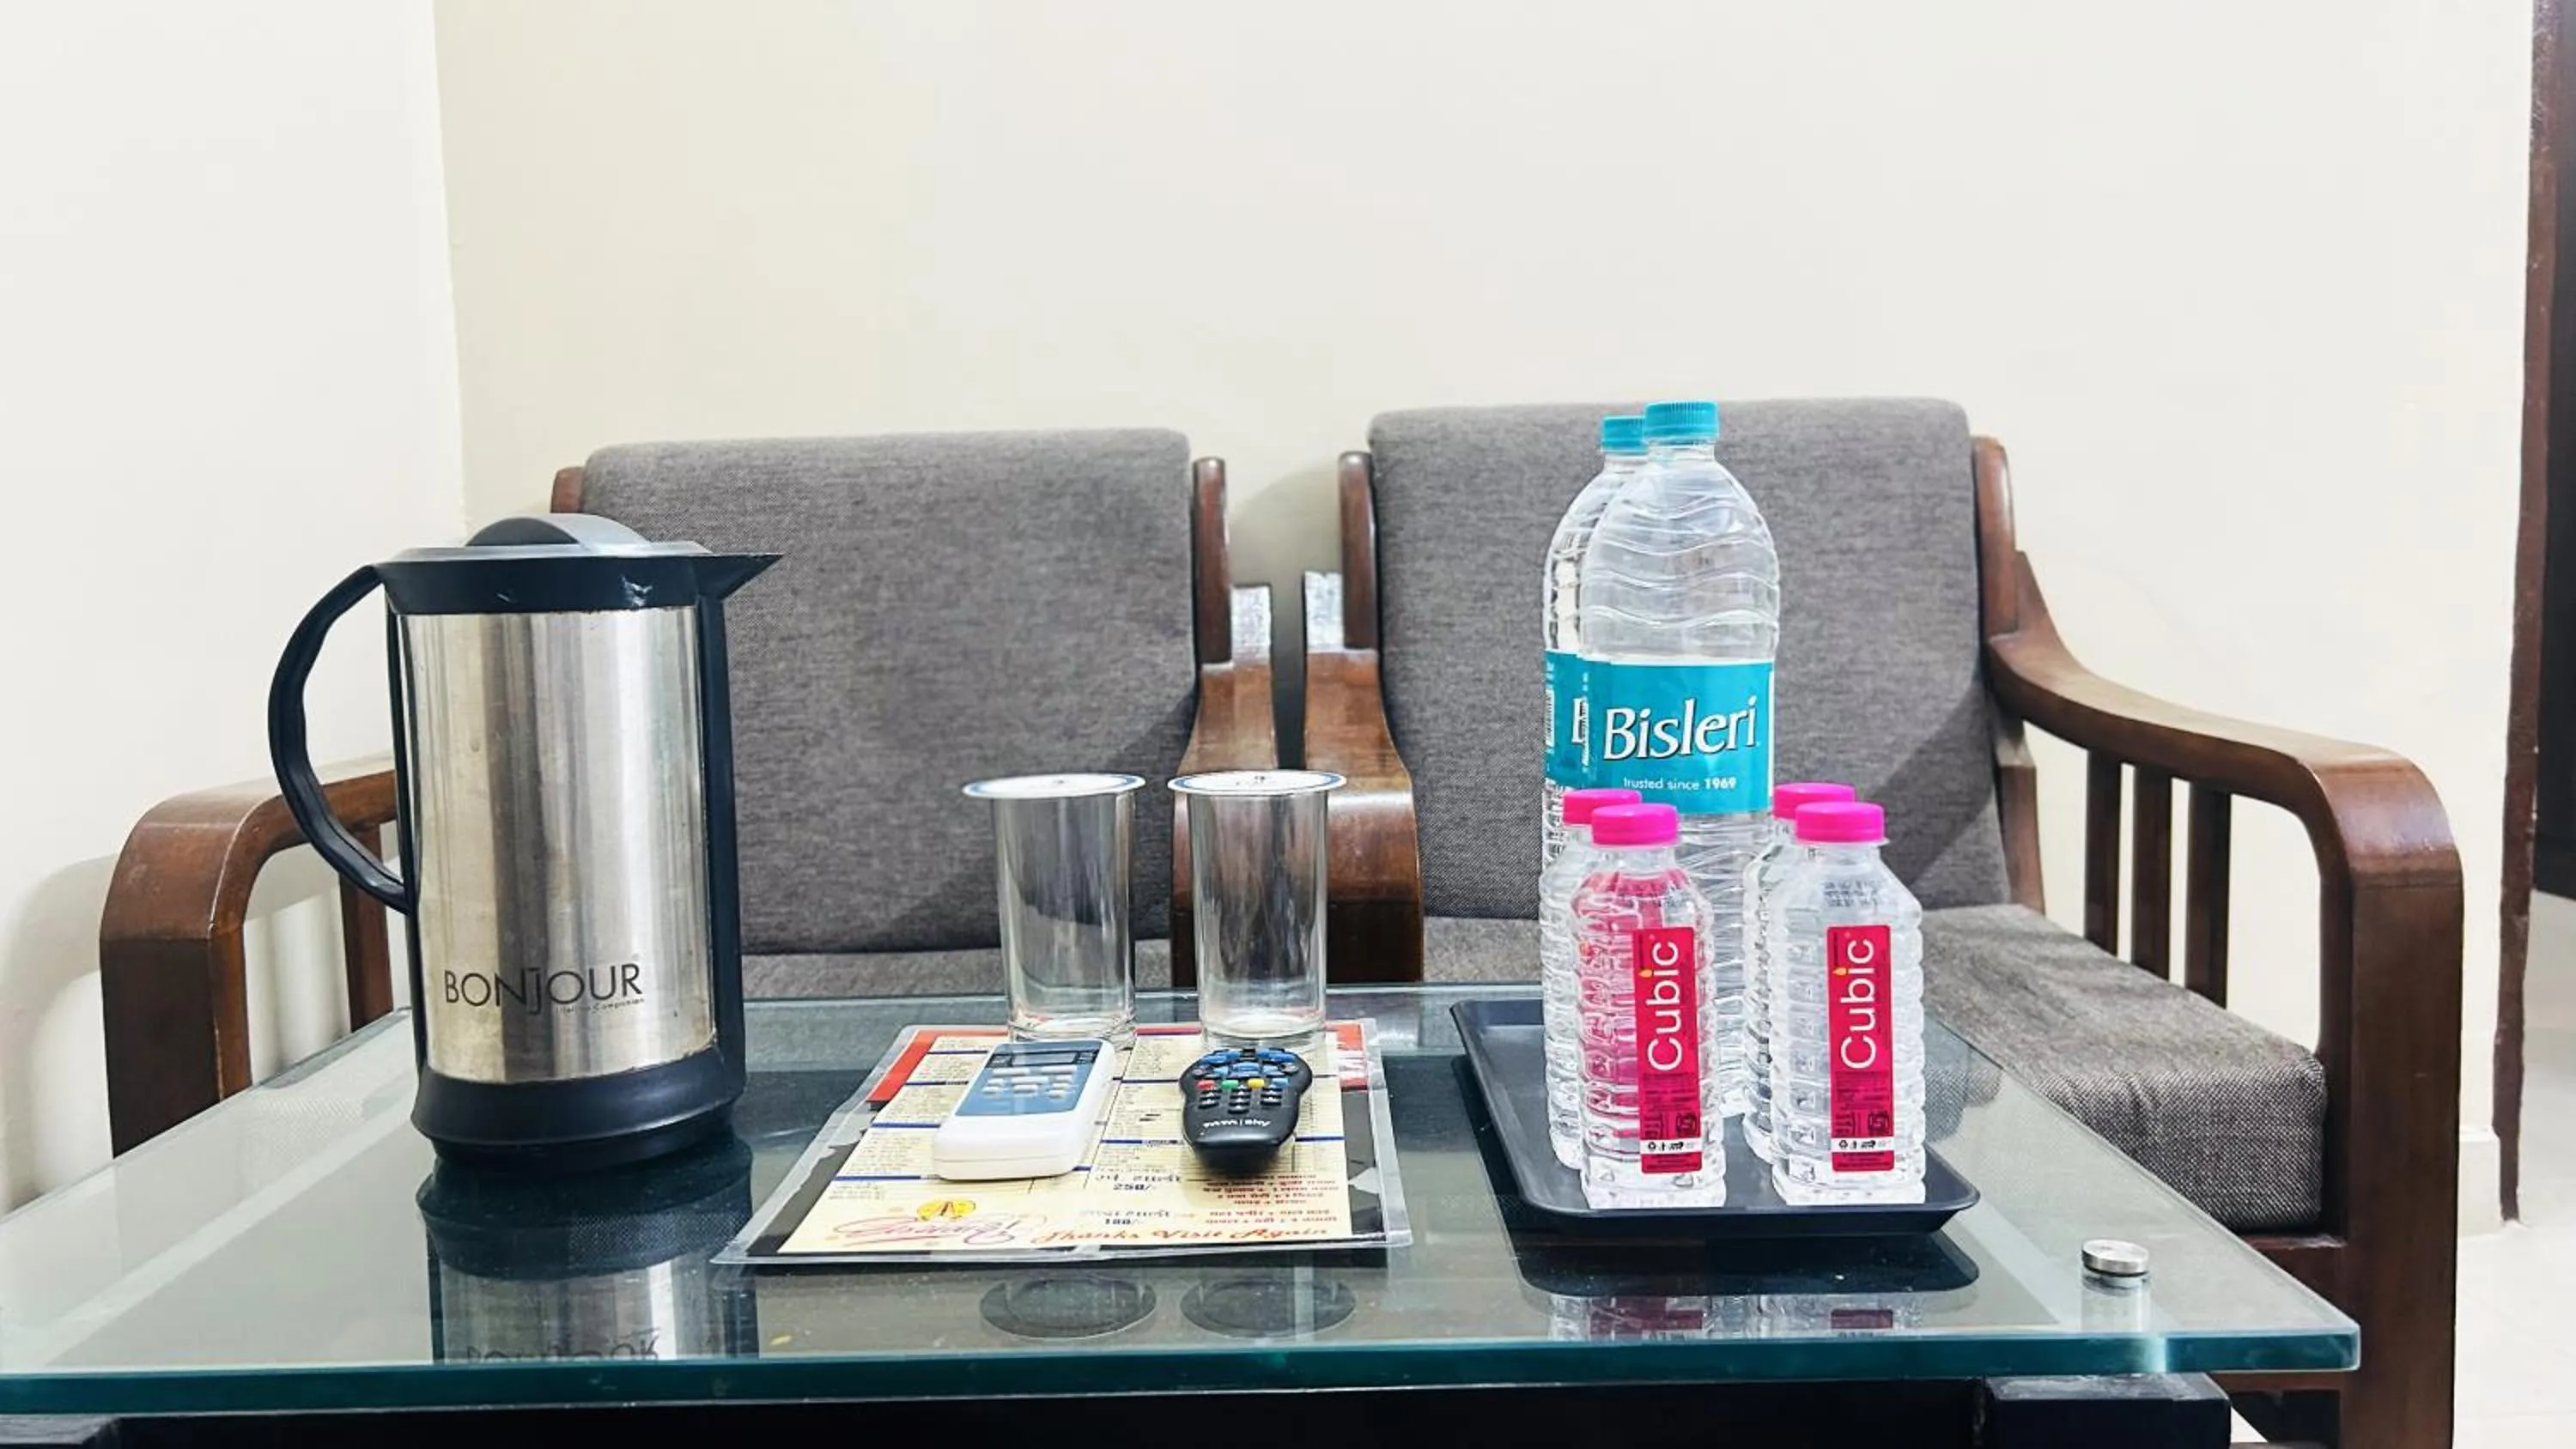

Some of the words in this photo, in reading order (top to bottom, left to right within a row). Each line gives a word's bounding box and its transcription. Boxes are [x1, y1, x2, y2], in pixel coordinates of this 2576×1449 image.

[1603, 695, 1758, 761] Bisleri
[1623, 778, 1663, 789] trusted
[1667, 779, 1699, 791] since
[1704, 777, 1737, 789] 1969
[444, 963, 643, 1016] BONJOUR
[1639, 941, 1684, 1071] Cubic
[1833, 939, 1877, 1070] Cubic
[1151, 1229, 1223, 1239] Visit
[1229, 1227, 1327, 1239] Again
